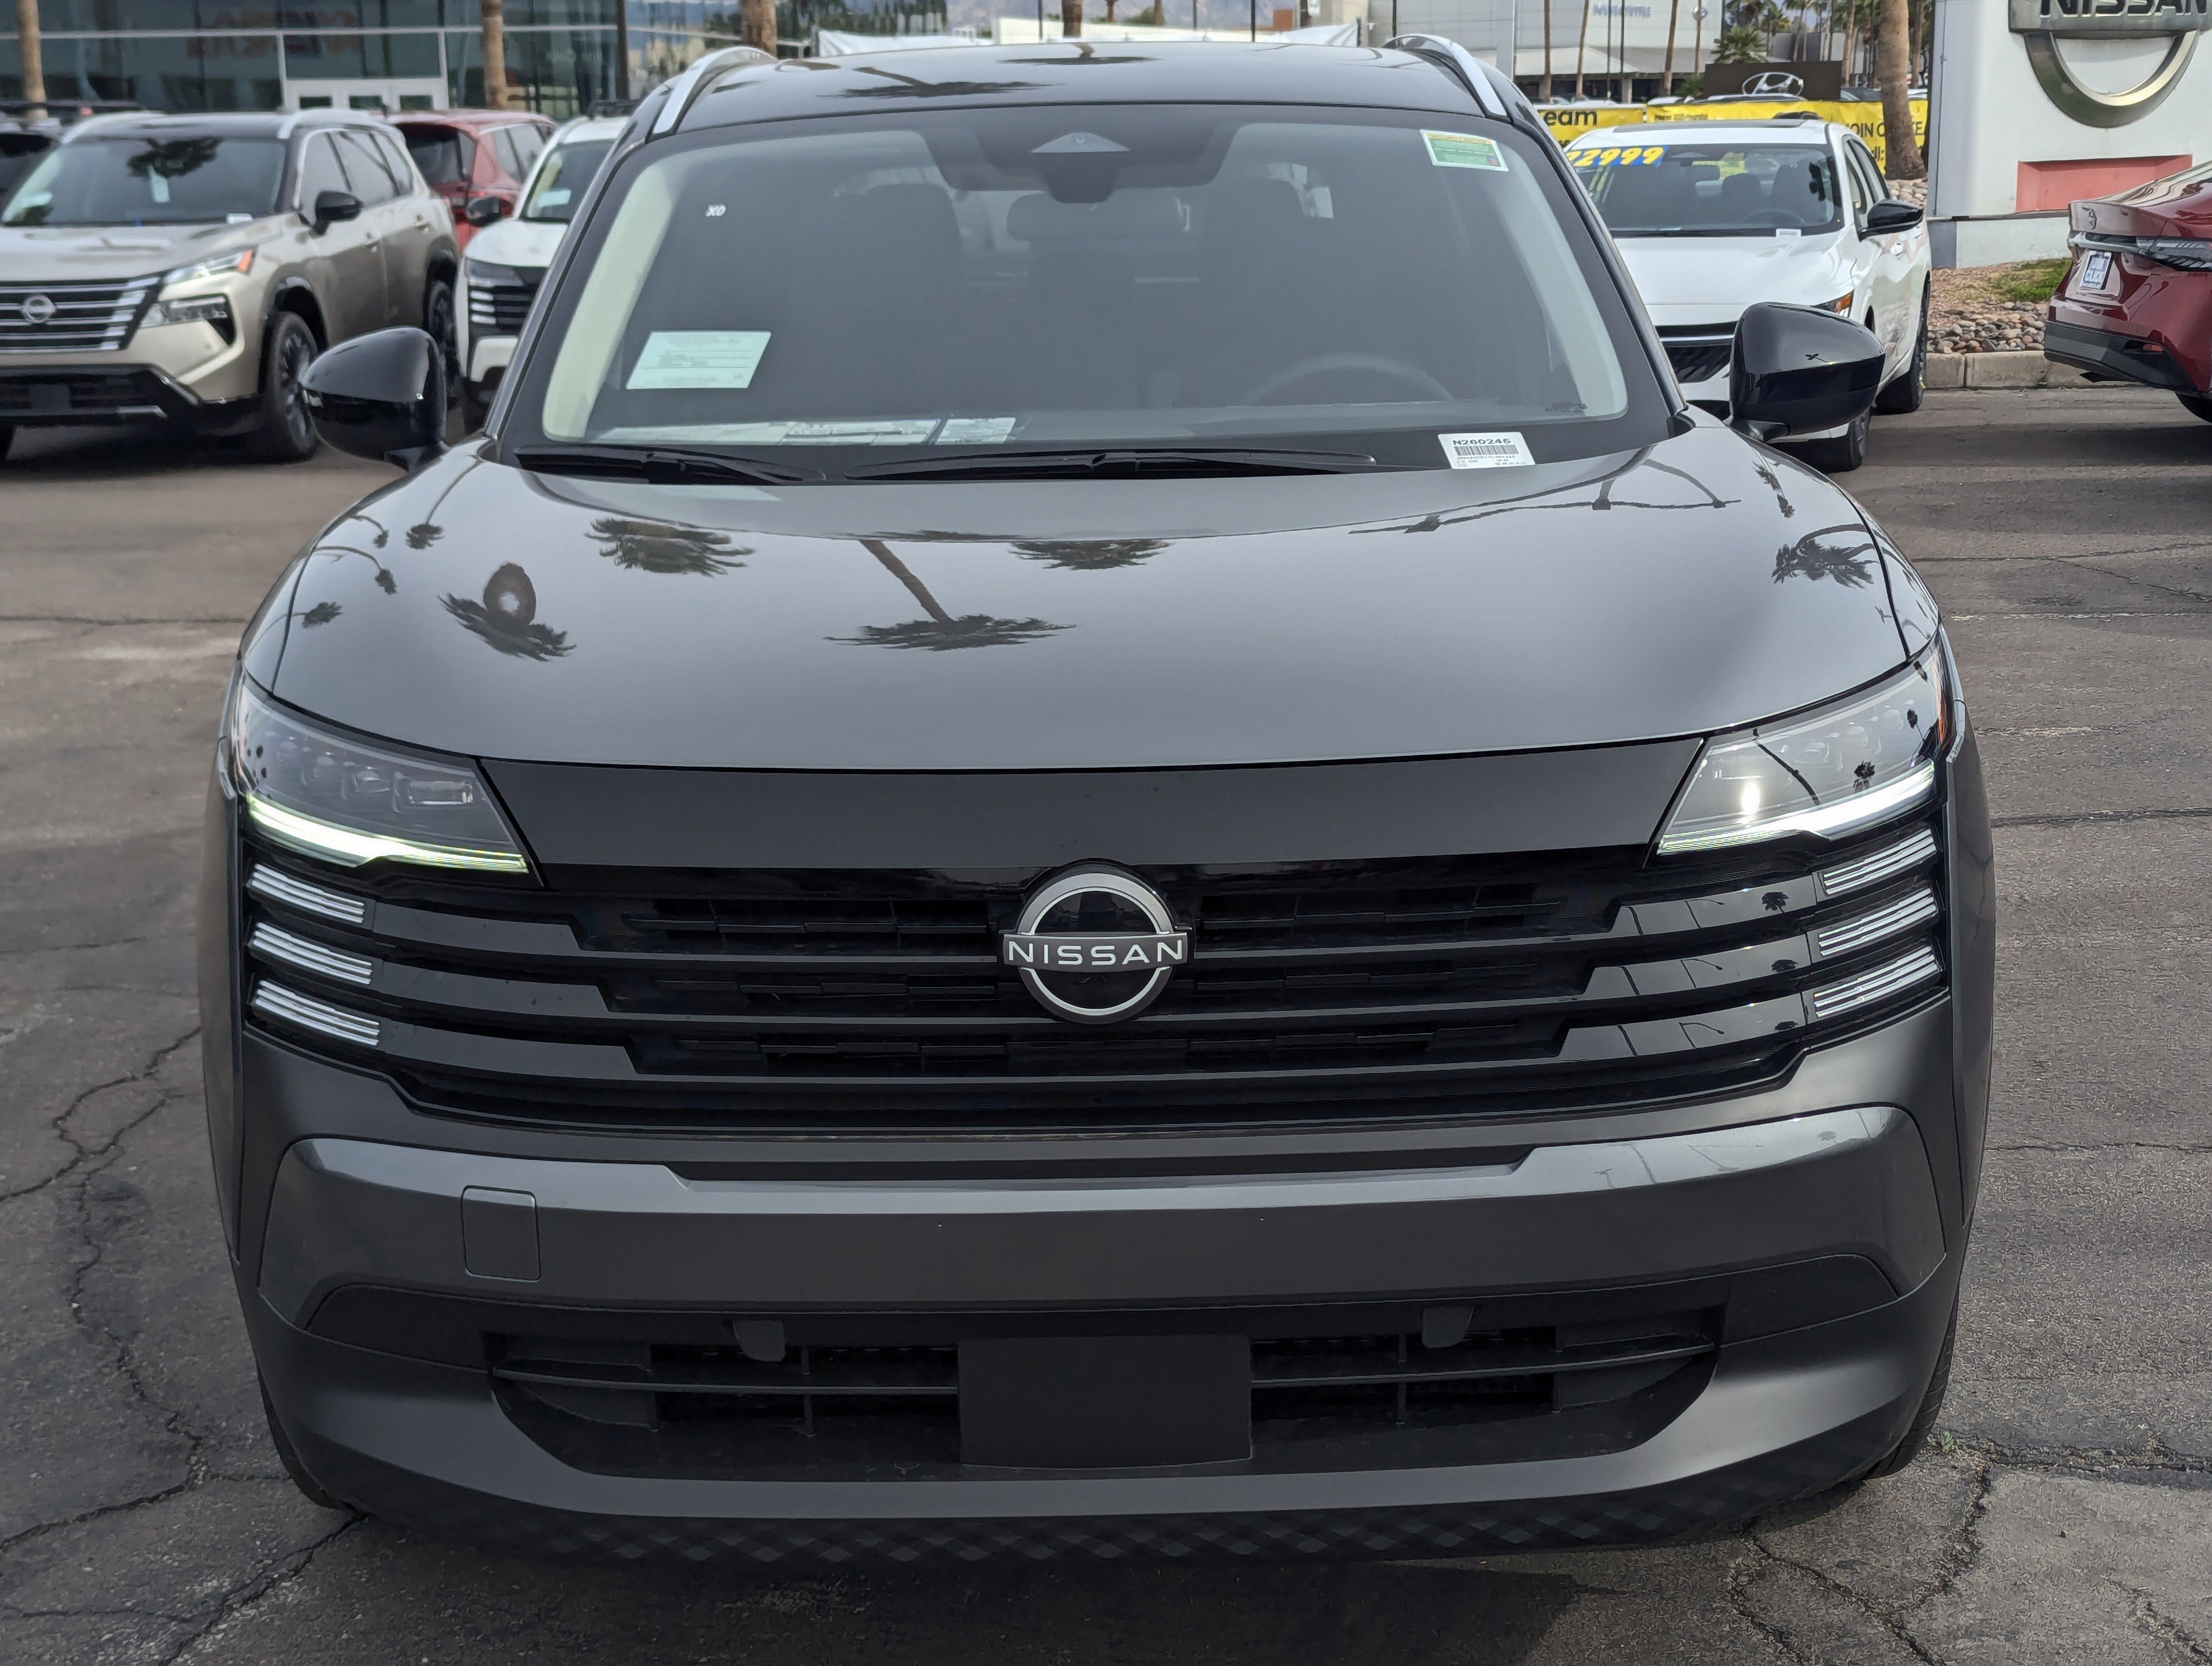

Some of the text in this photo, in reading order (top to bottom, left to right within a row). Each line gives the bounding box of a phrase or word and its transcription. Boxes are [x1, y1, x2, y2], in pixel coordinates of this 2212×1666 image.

[1538, 110, 1597, 126] eam
[1846, 123, 1874, 138] OIN
[1008, 939, 1182, 965] NISSAN
